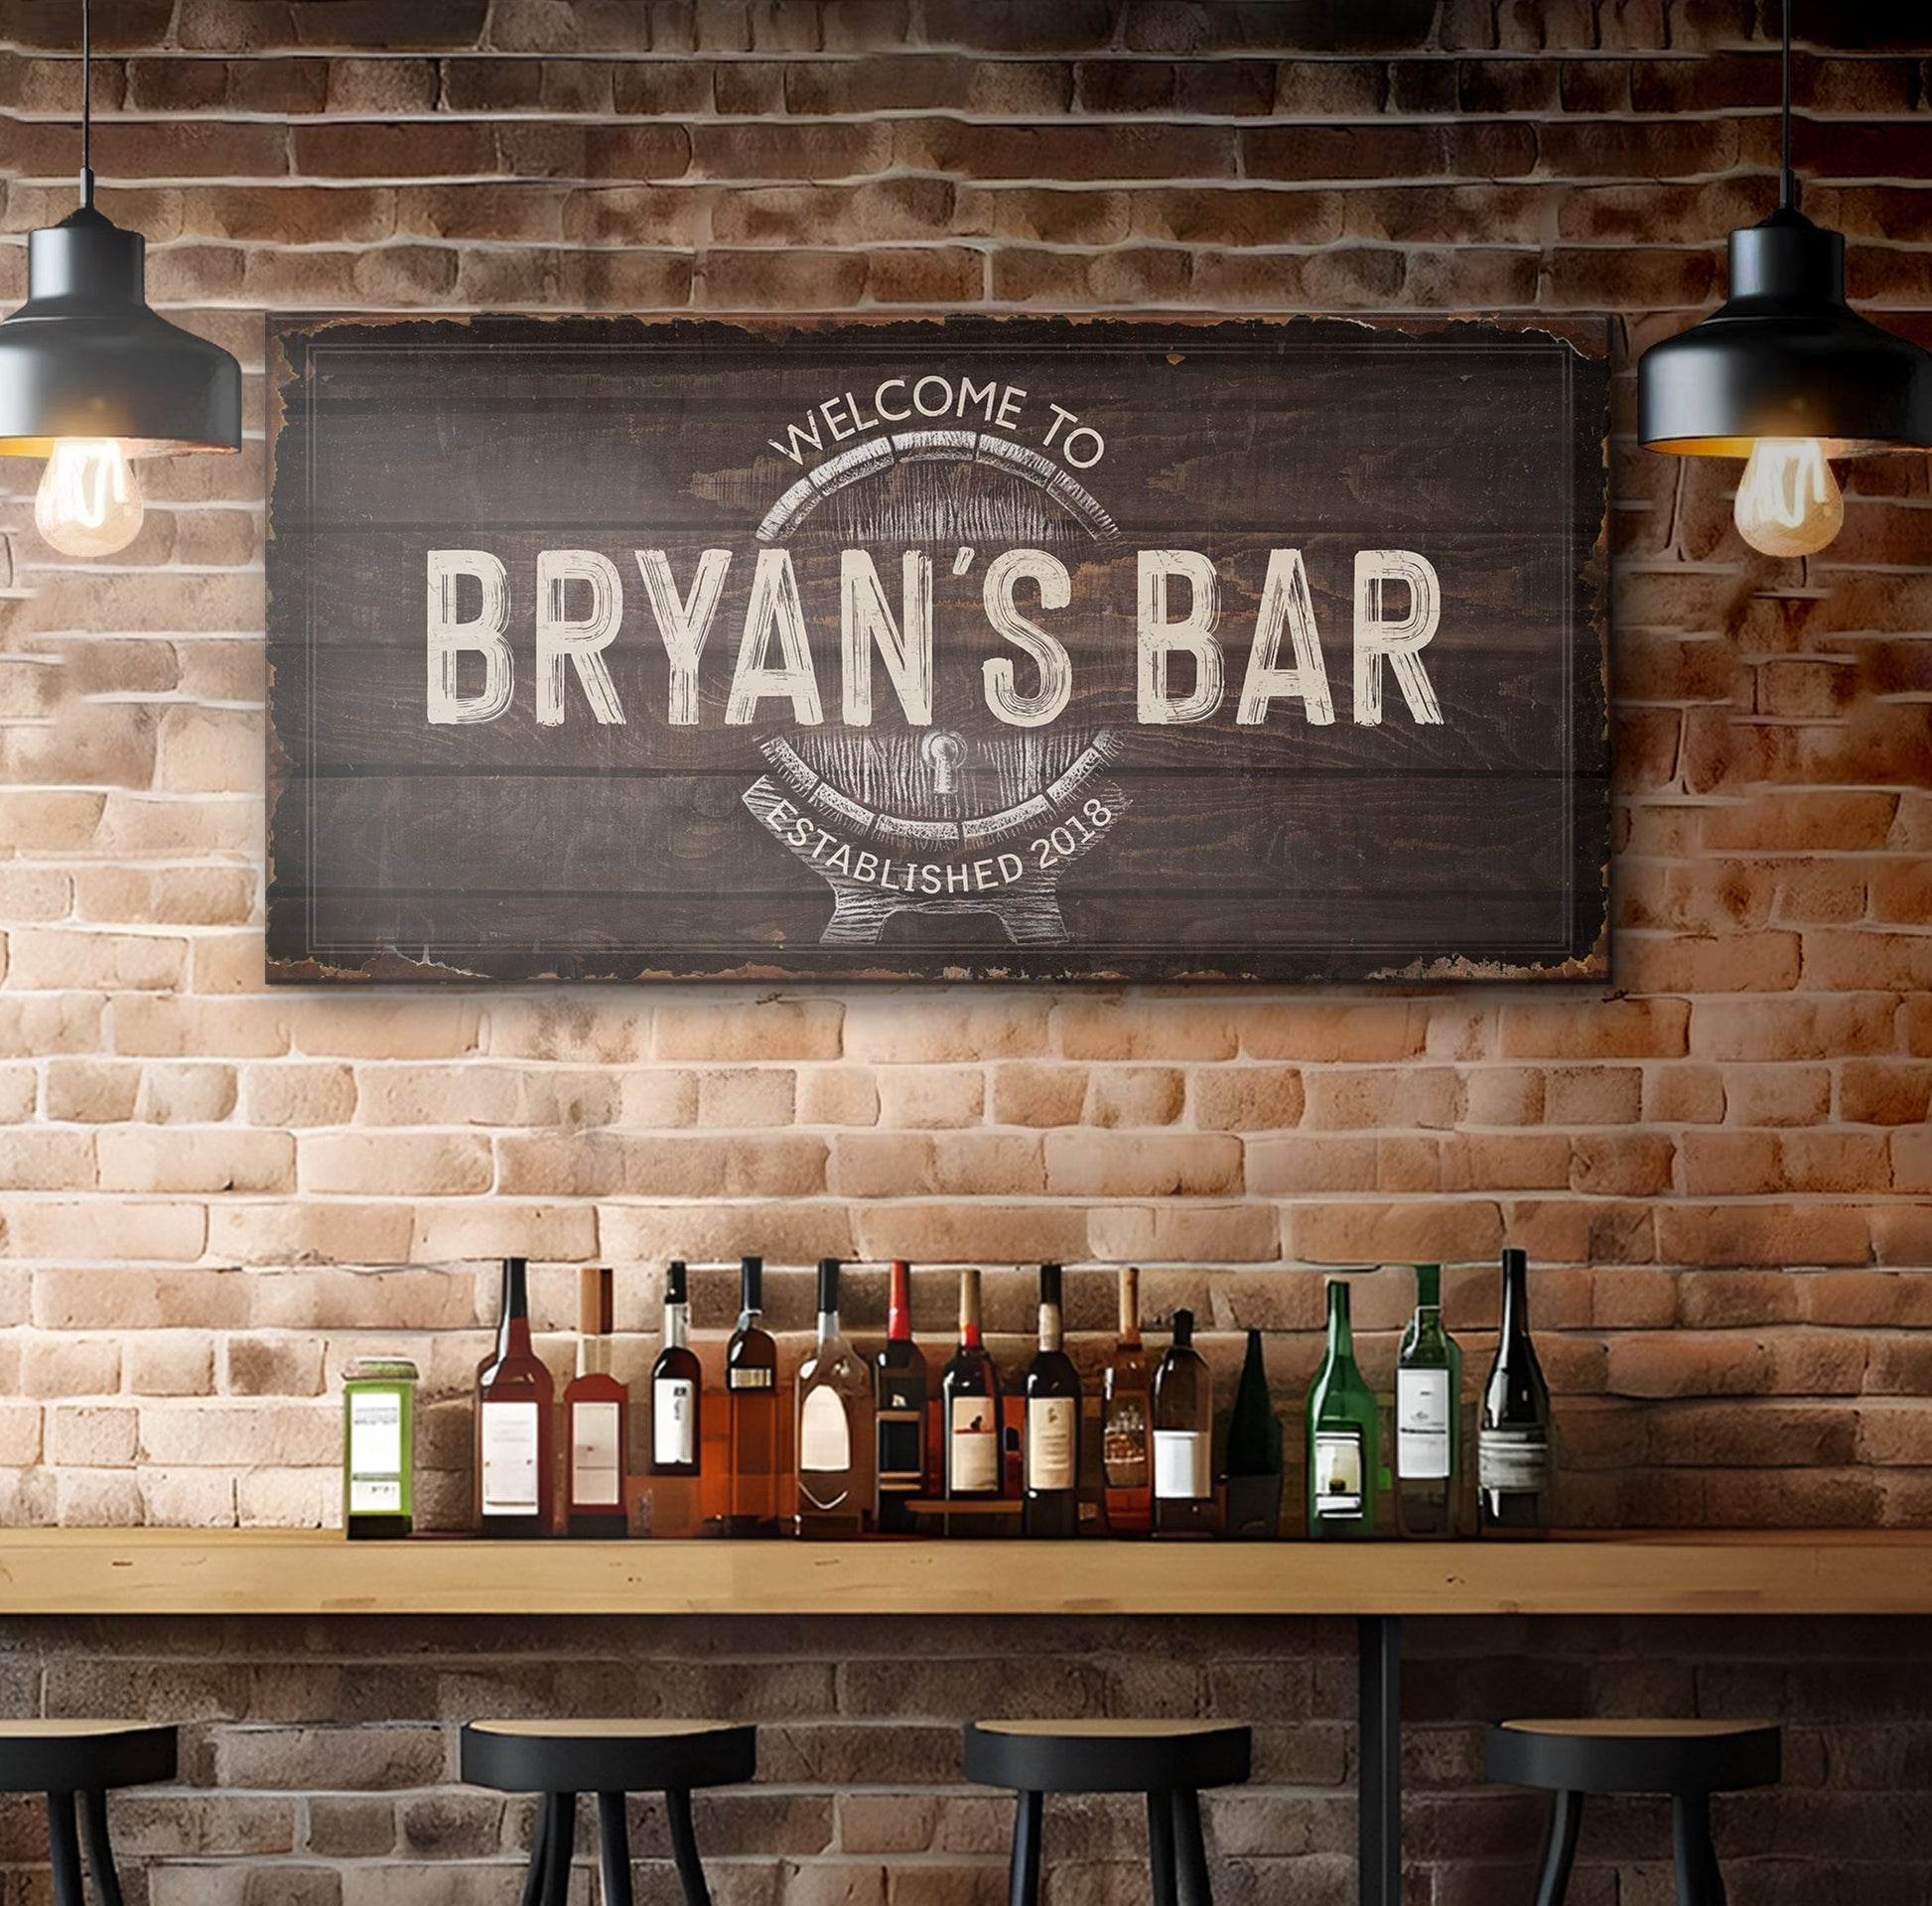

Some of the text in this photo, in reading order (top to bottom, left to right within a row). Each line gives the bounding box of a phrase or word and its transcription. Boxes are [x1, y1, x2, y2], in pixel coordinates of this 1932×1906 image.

[766, 374, 1105, 470] WELCOME TO
[425, 546, 1446, 728] BRYAN’S BAR
[765, 798, 1113, 894] ESTABLISHED 2018
